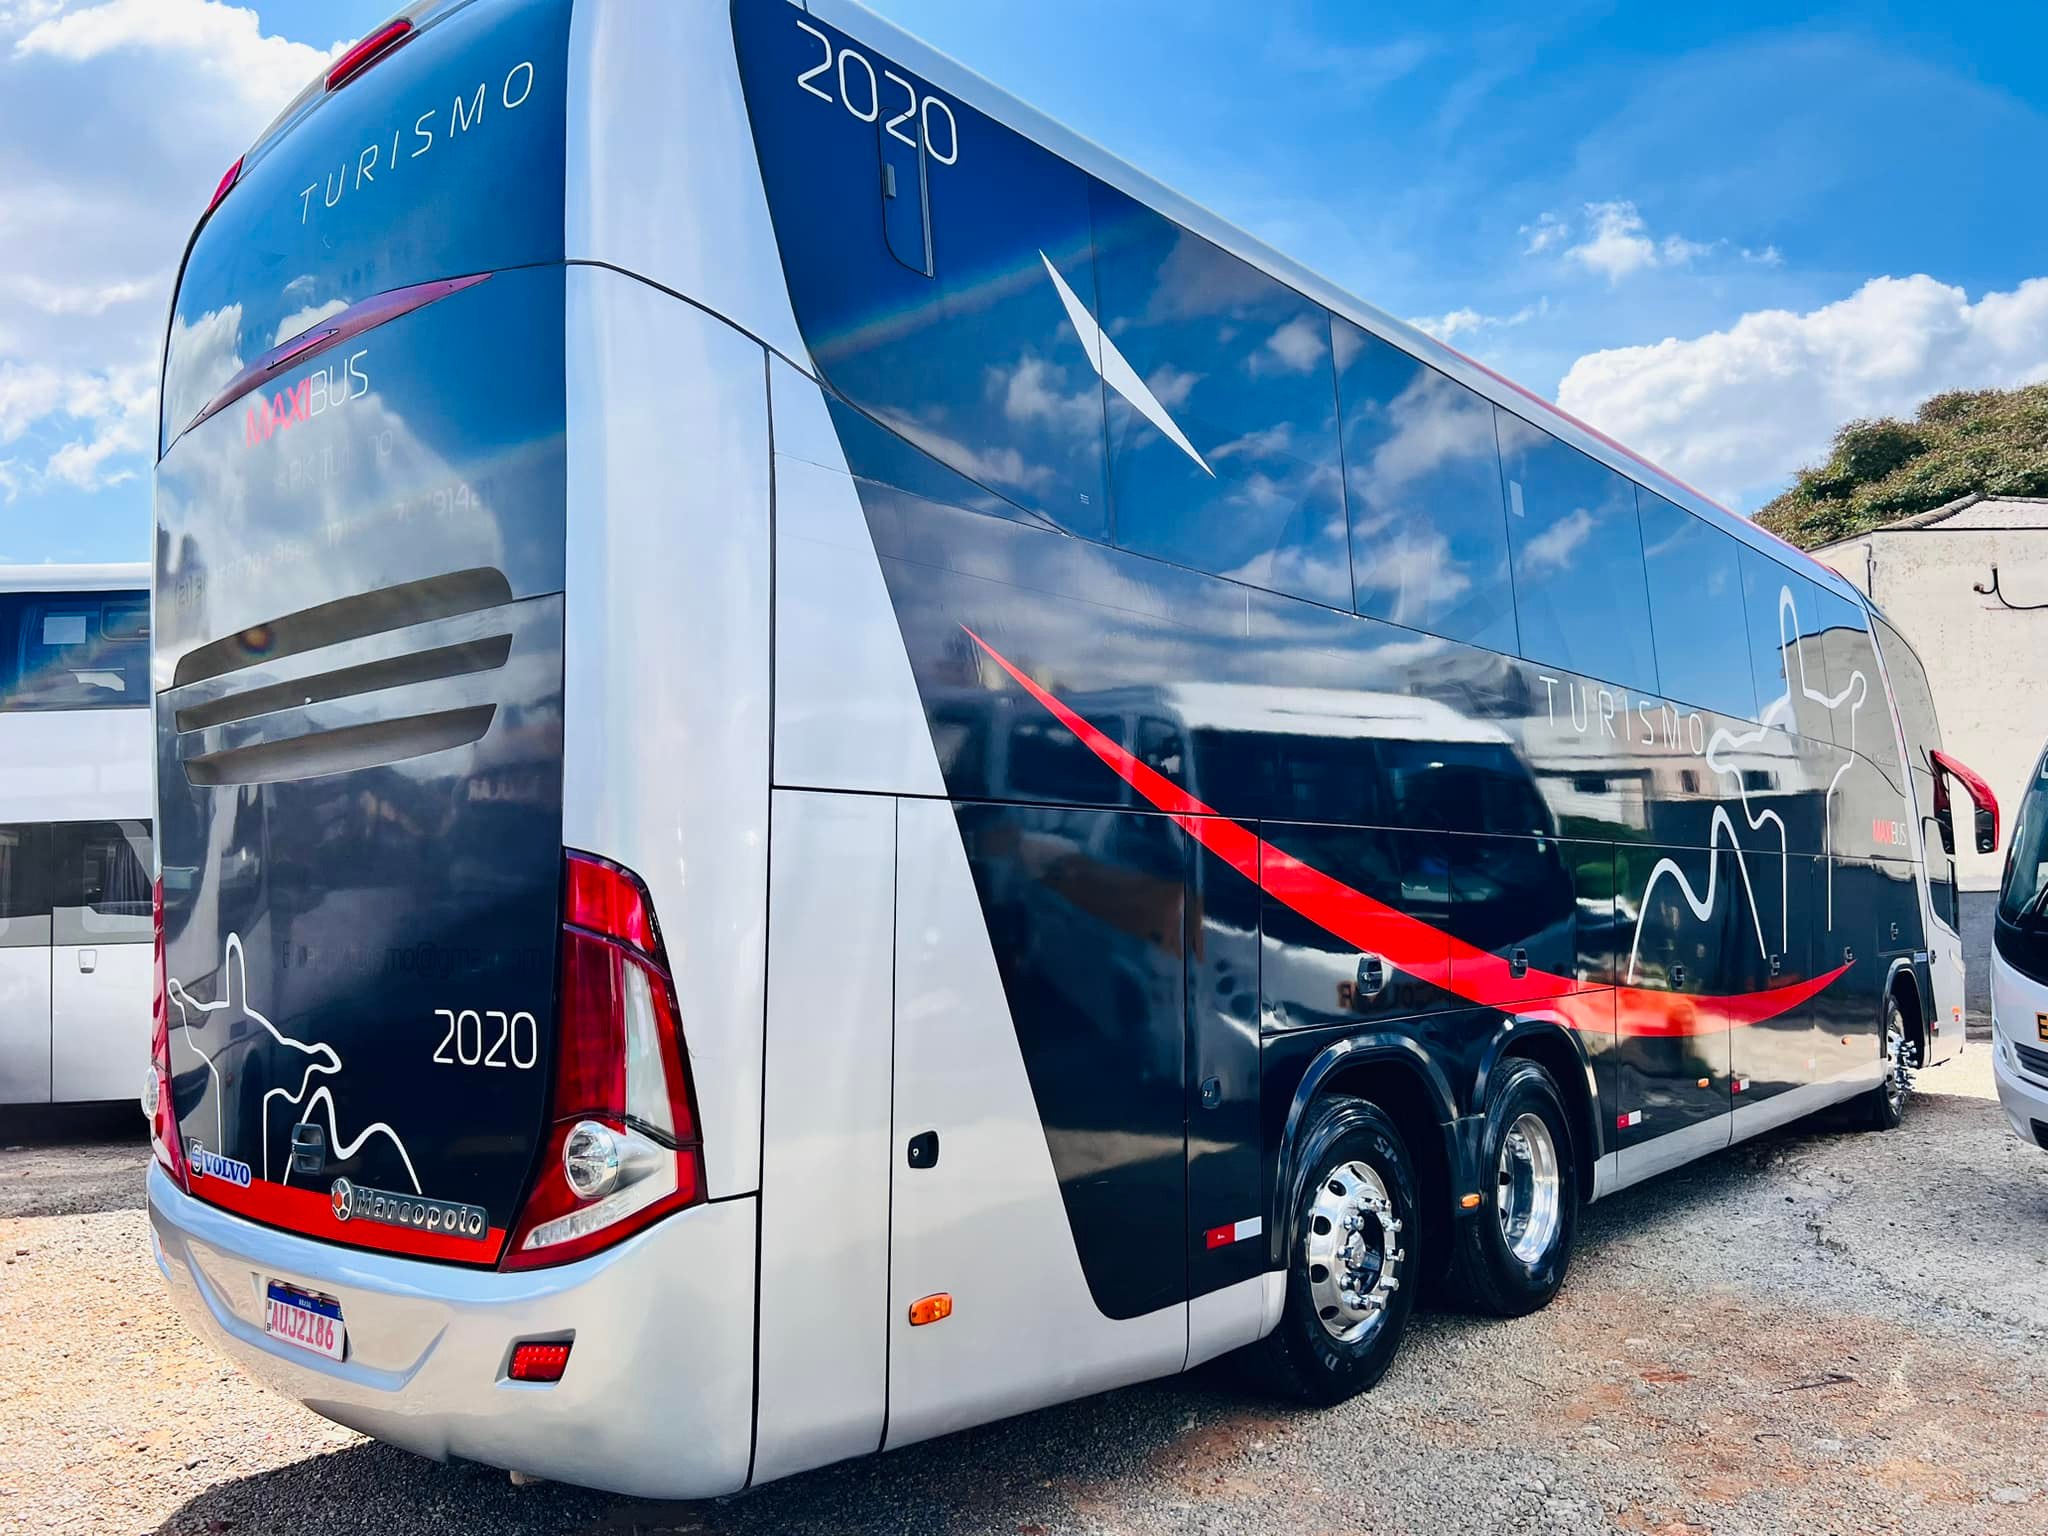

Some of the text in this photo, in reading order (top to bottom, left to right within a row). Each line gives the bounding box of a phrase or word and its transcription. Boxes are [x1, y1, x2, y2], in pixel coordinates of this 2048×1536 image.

[796, 19, 958, 166] 2020
[300, 61, 534, 225] TURISMO
[246, 349, 369, 449] MAXIBUS
[1538, 675, 1704, 756] TURISMO
[432, 1008, 538, 1070] 2020
[203, 1155, 250, 1185] VOLVO
[356, 1188, 483, 1236] Marcopolo
